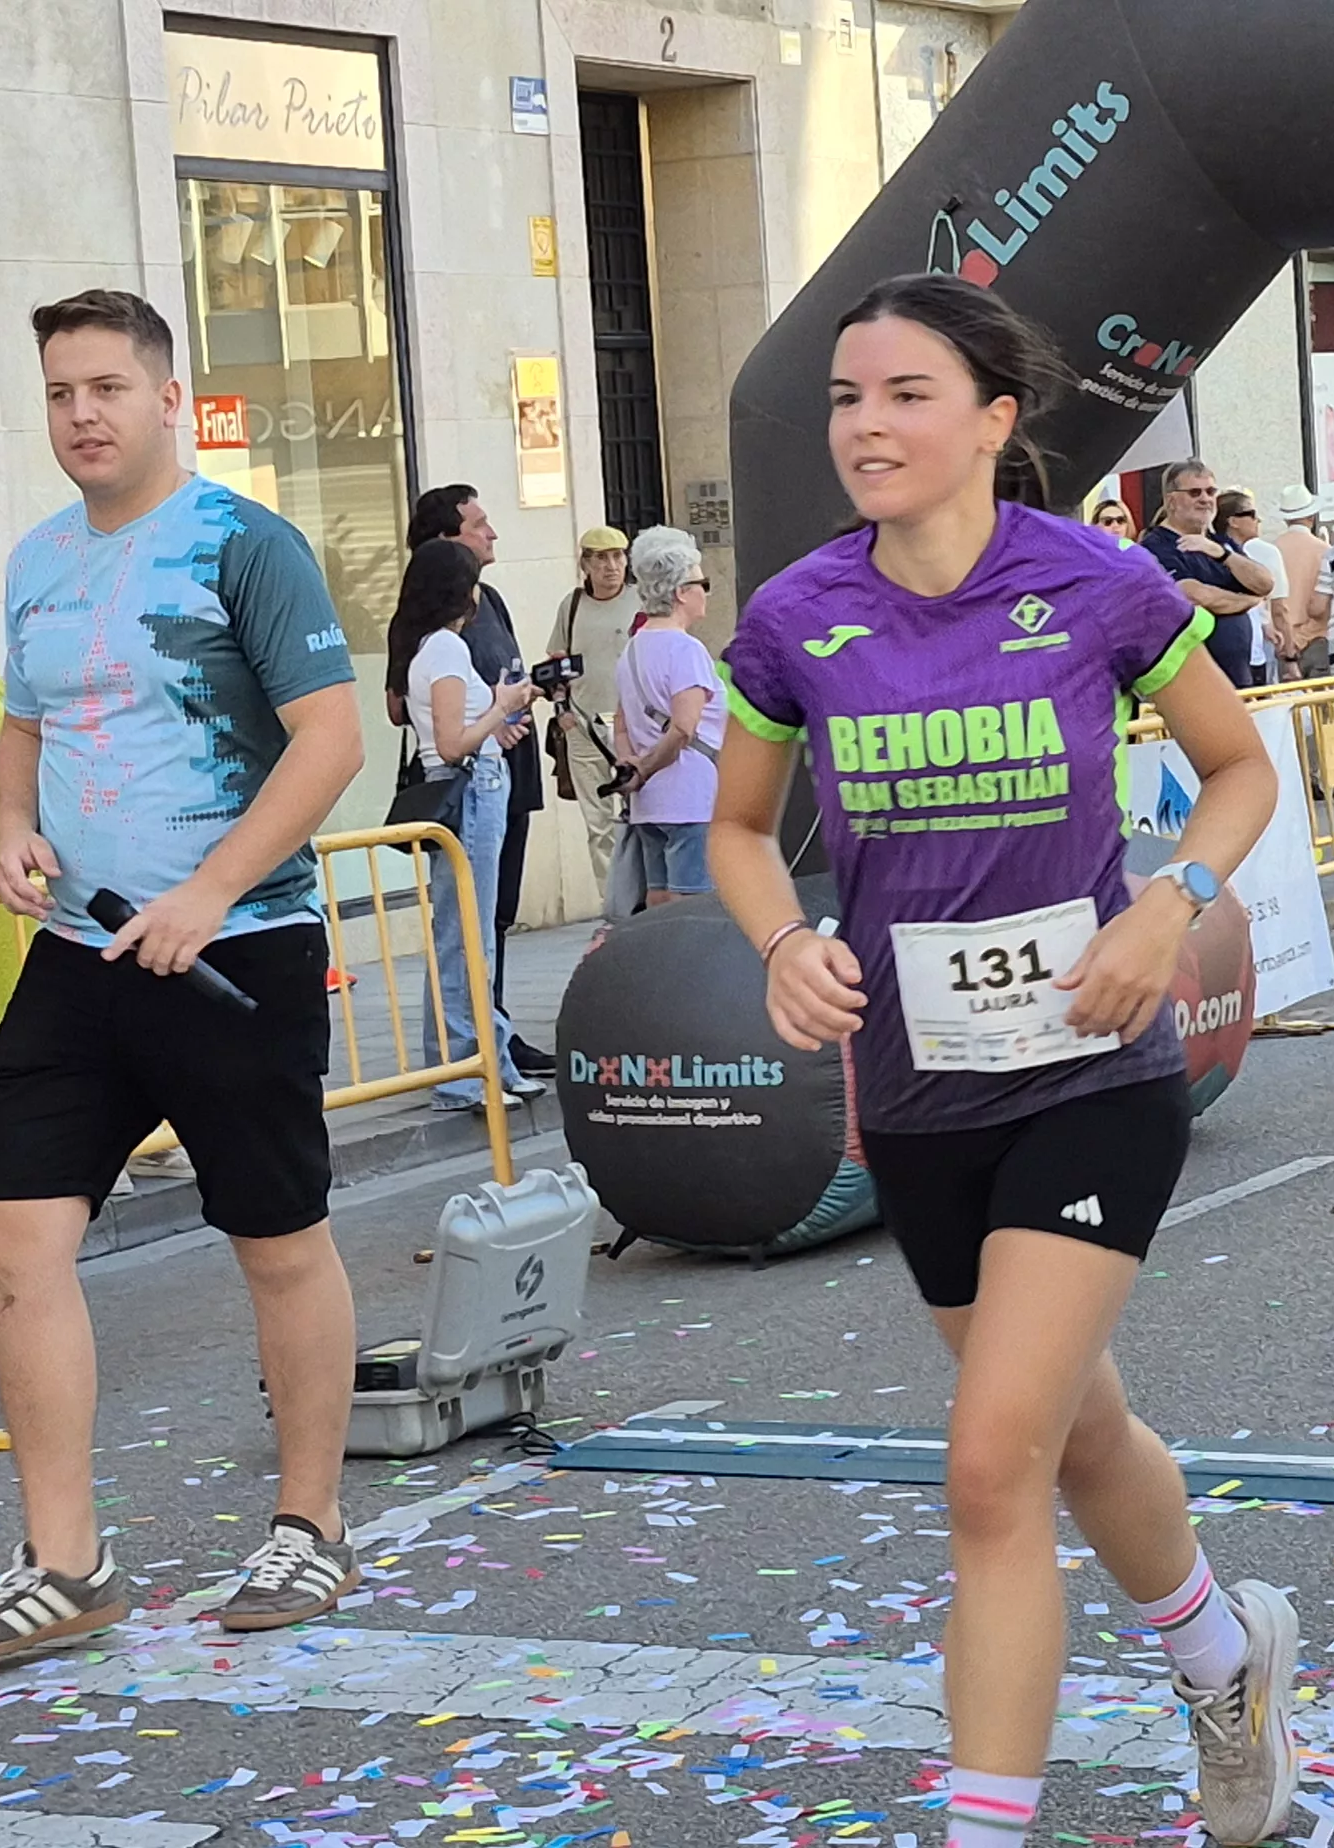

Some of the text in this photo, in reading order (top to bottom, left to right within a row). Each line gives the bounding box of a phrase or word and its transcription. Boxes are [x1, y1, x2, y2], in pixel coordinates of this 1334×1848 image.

[659, 15, 678, 63] 2
[177, 65, 376, 141] Pilar Prieto
[201, 399, 244, 442] Final
[827, 697, 1066, 773] BEHOBIA
[895, 758, 1070, 810] SEBASTIÁN
[948, 939, 1054, 992] 131
[969, 991, 1039, 1014] LAURA
